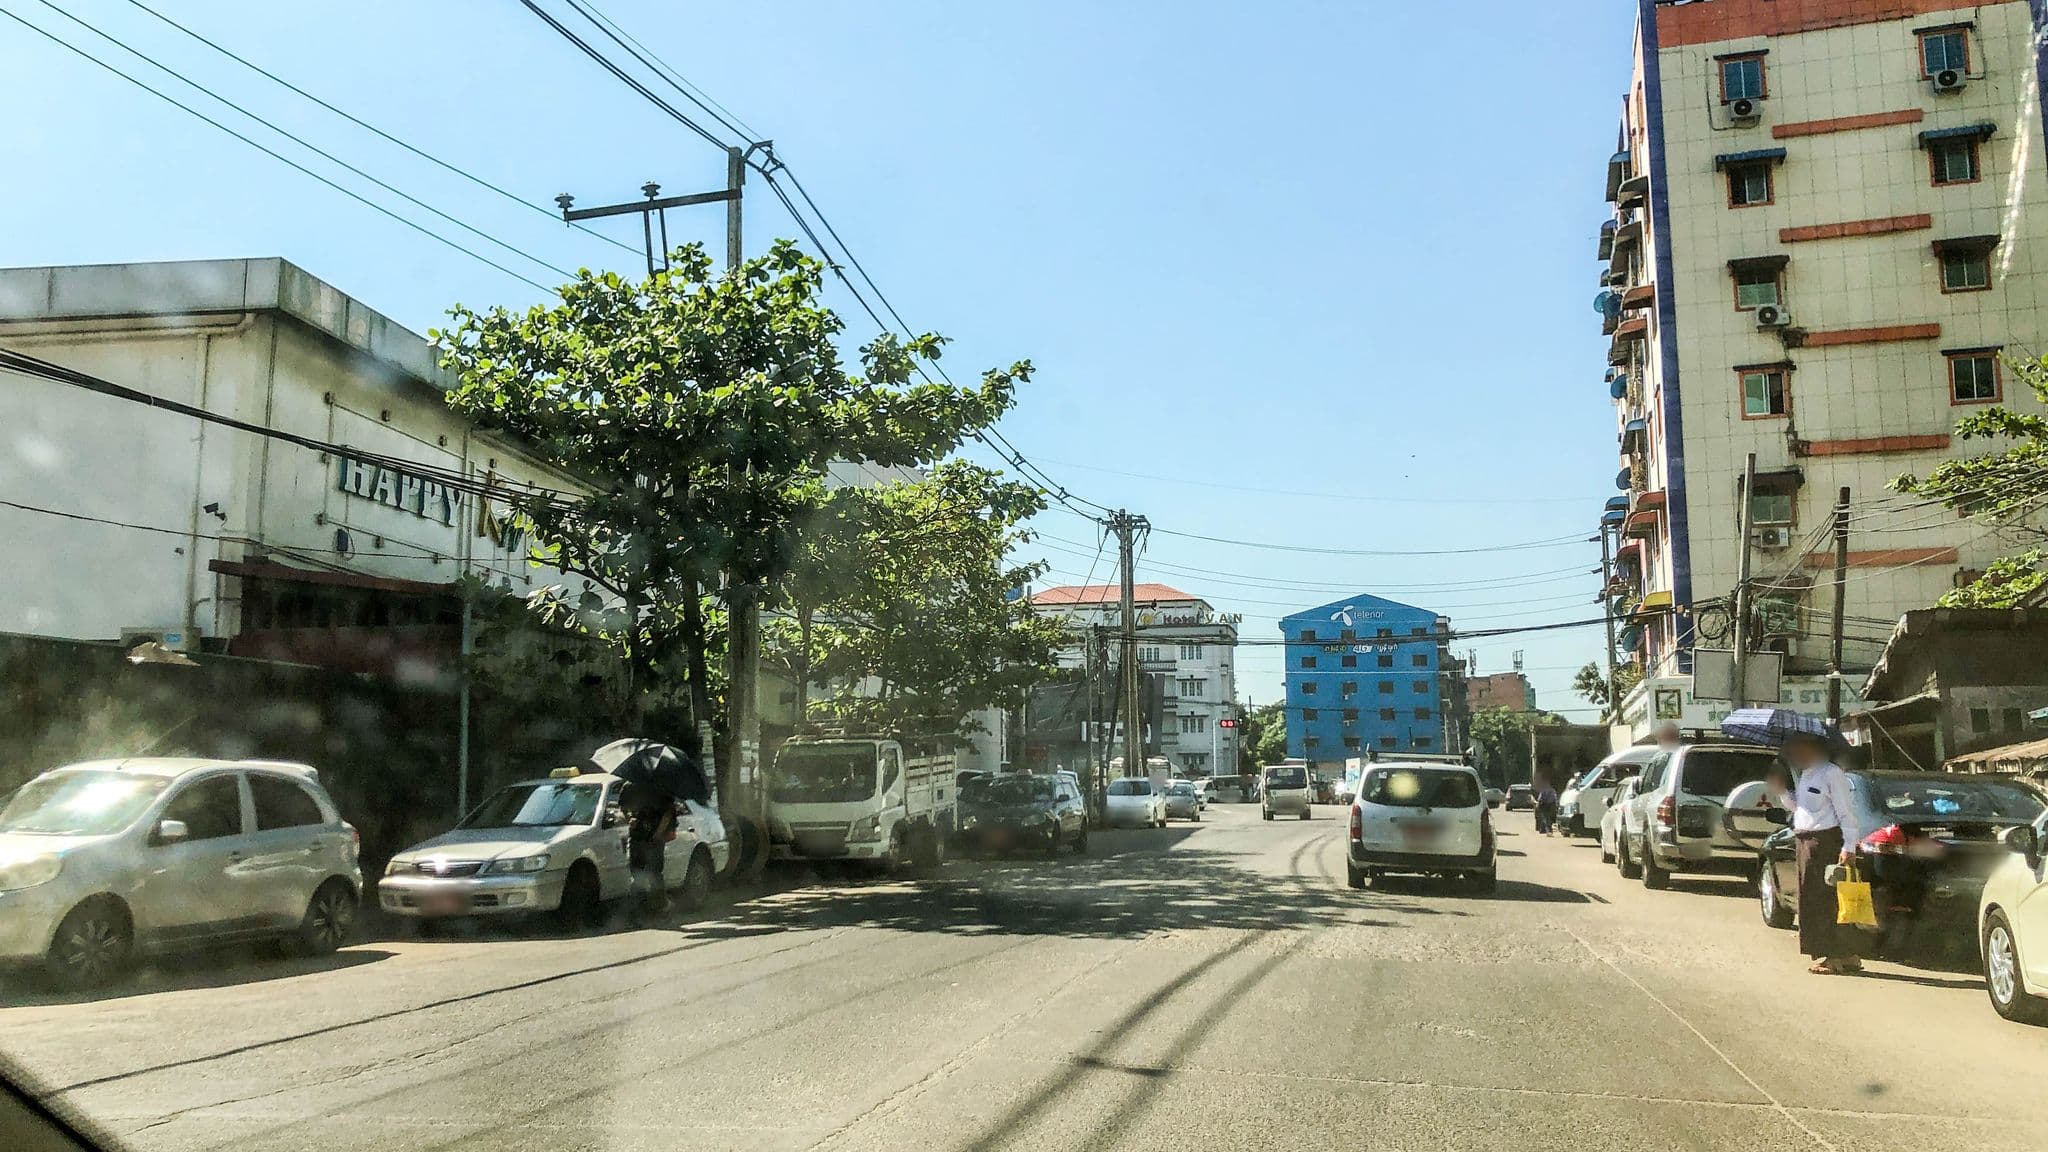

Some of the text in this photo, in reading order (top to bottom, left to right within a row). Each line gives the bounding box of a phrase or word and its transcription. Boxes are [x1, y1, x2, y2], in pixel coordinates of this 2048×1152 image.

[341, 455, 465, 527] HAPPY
[1163, 611, 1200, 625] Hotel
[1353, 610, 1384, 619] telenor
